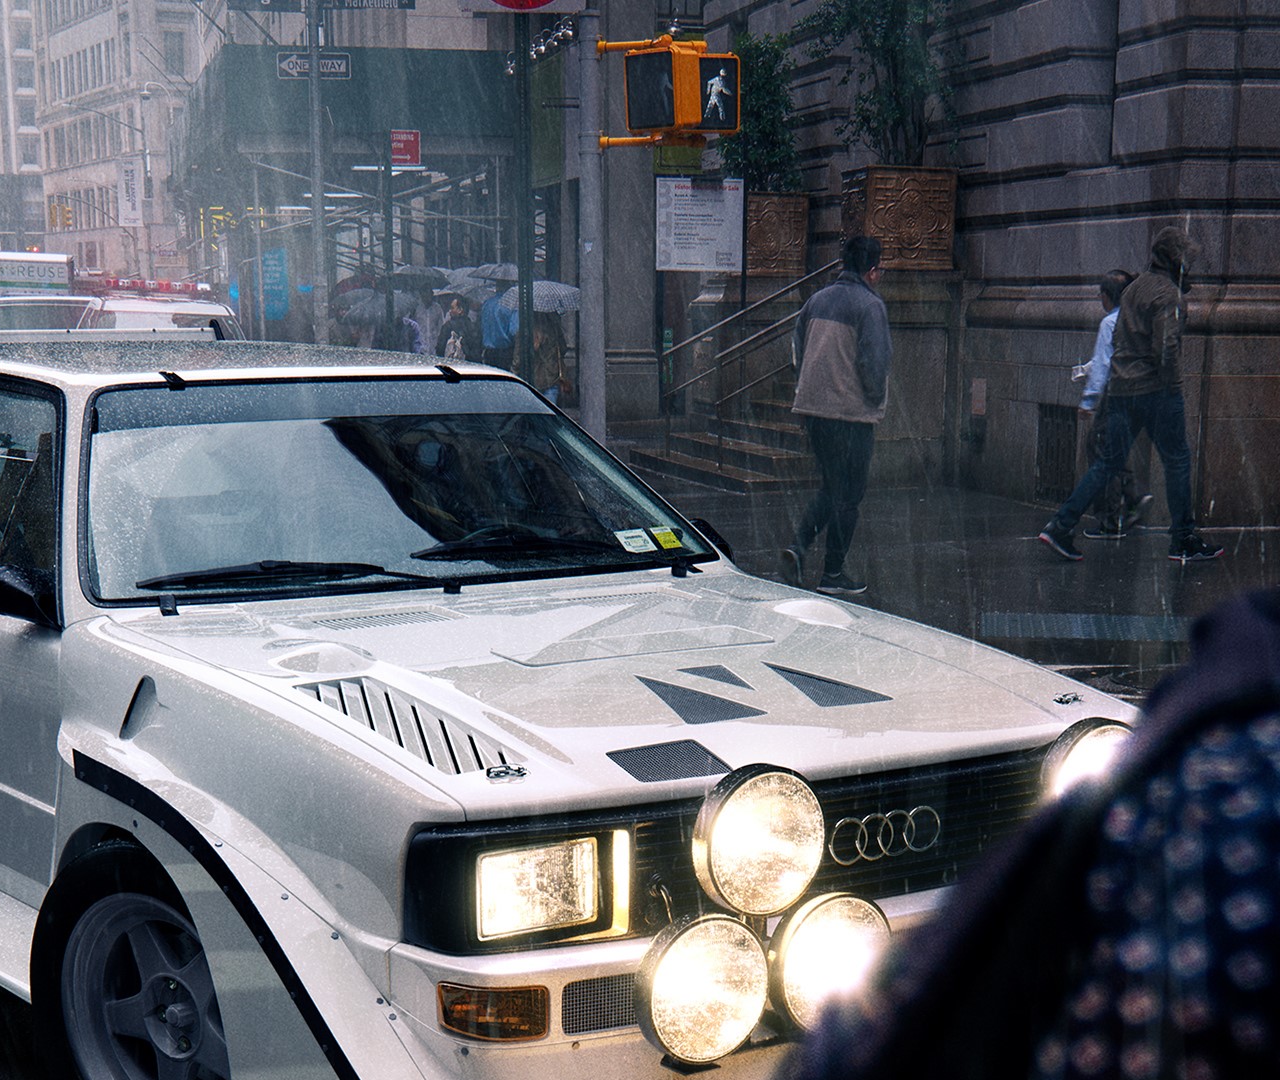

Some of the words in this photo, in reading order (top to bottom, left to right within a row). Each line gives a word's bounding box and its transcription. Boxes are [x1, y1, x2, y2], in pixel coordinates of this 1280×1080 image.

[287, 62, 309, 71] ONE
[320, 62, 344, 71] WAY
[17, 265, 65, 279] REUSE
